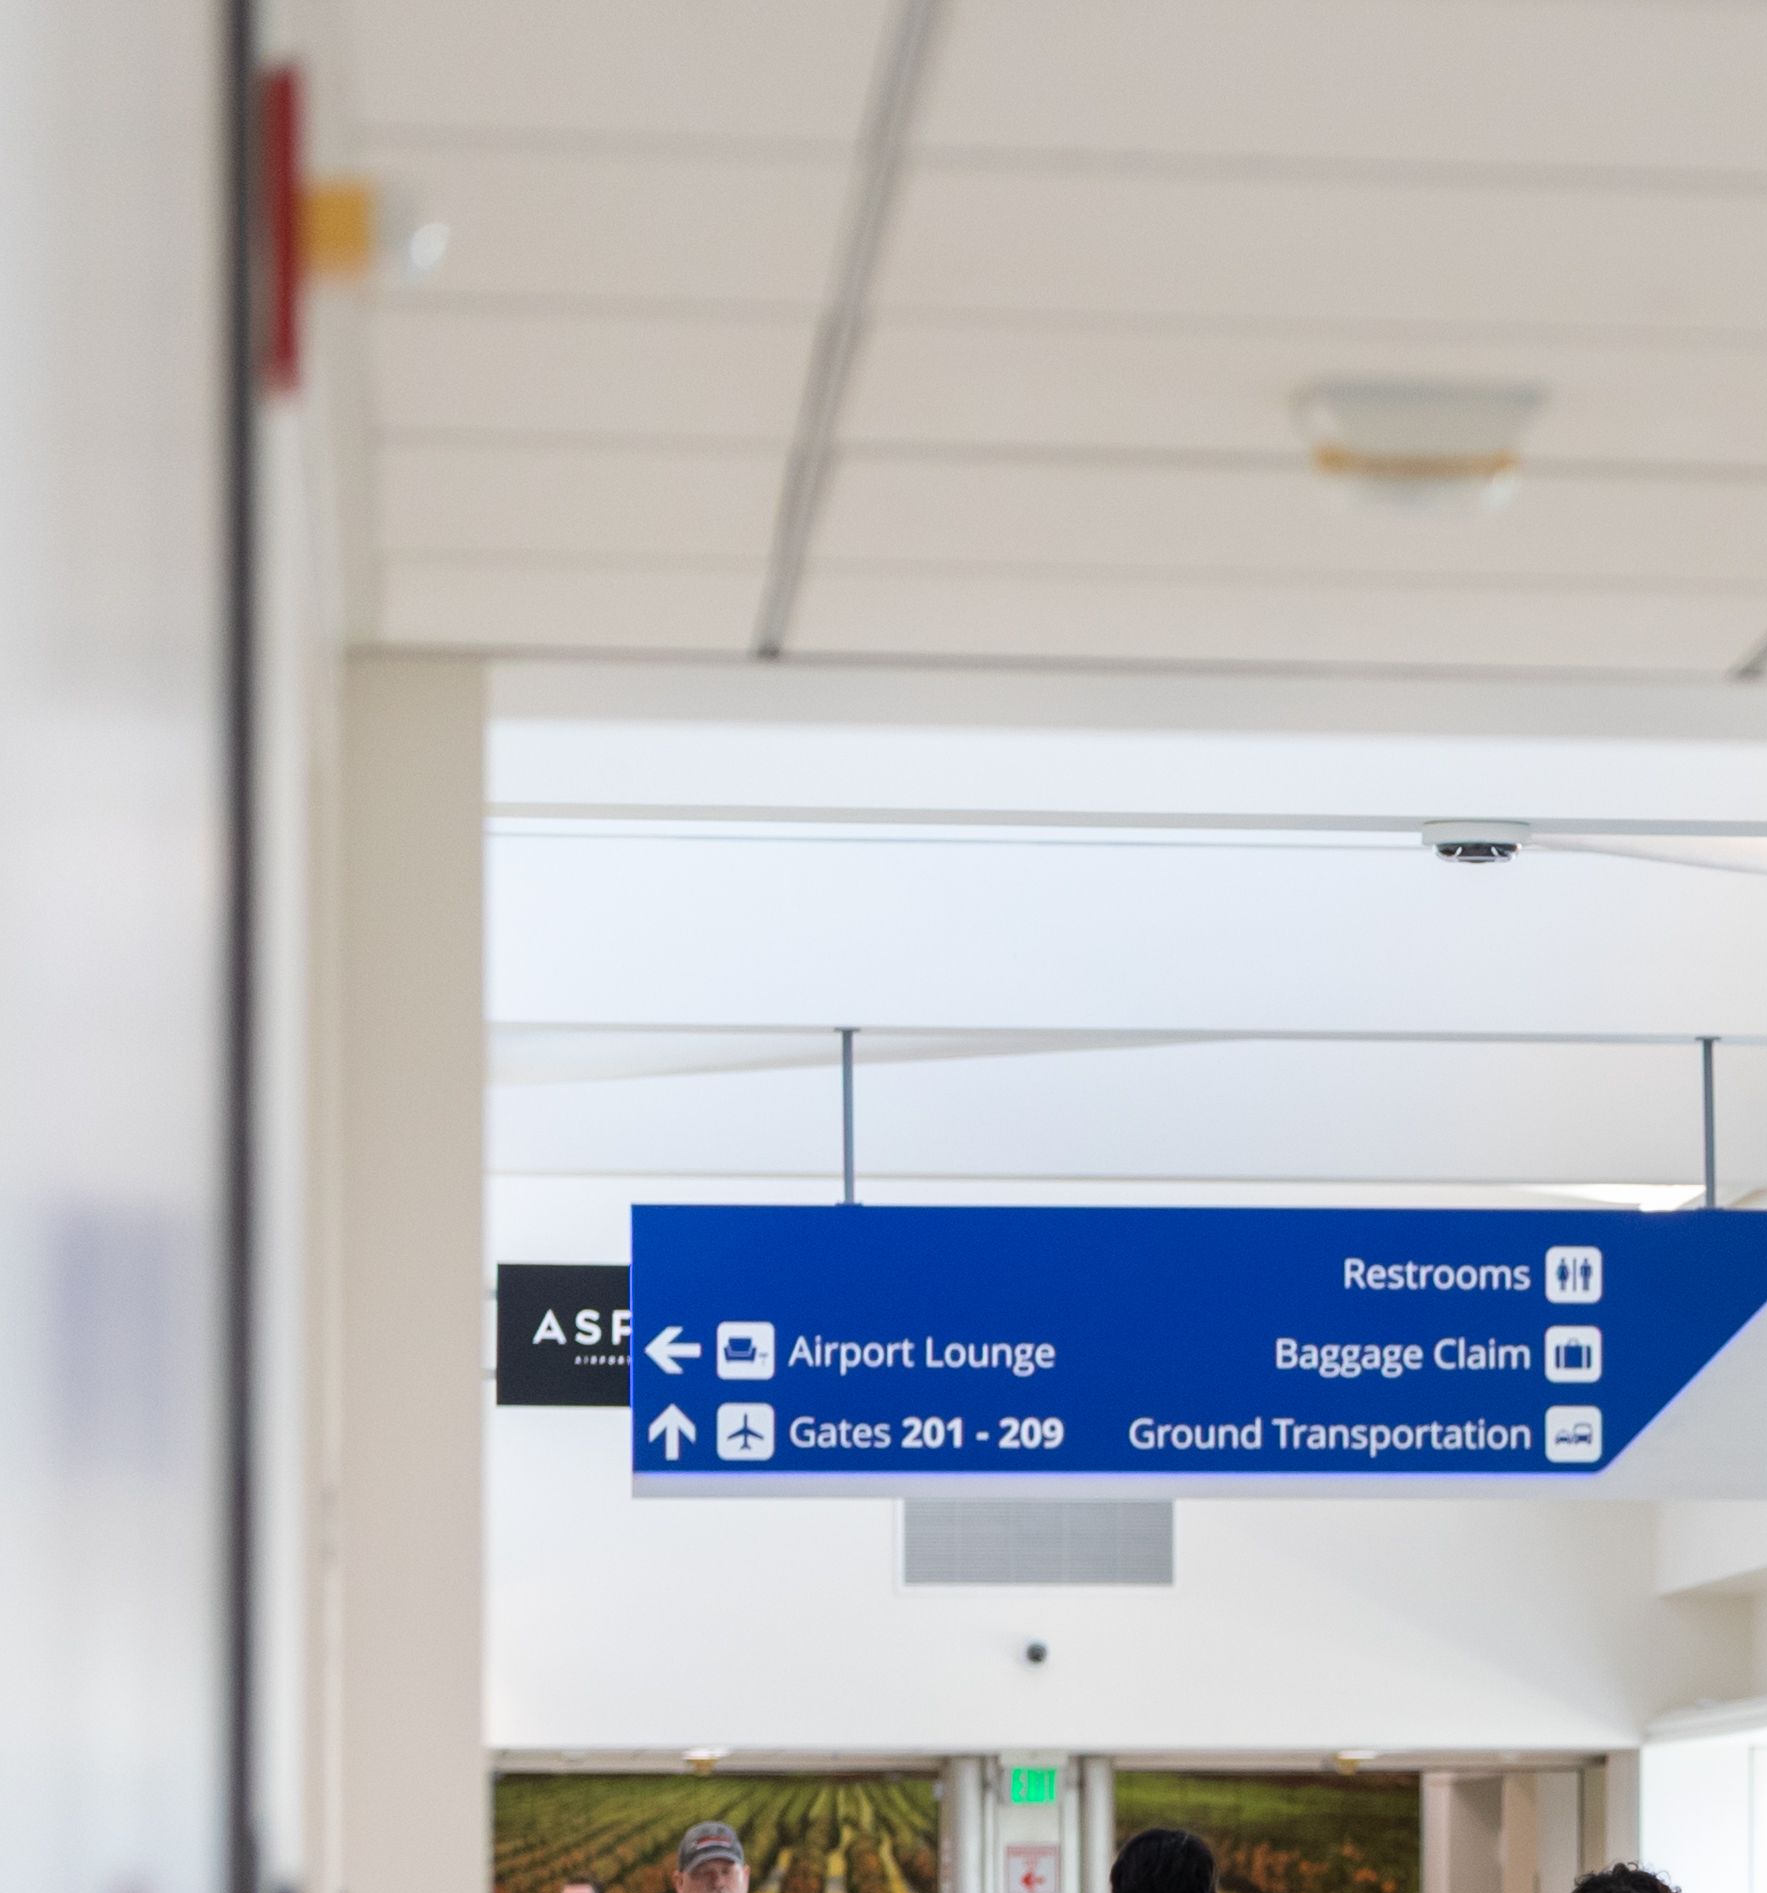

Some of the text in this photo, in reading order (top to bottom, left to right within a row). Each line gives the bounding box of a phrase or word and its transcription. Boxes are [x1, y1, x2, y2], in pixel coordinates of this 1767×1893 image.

[1344, 1257, 1531, 1291] Restrooms
[532, 1308, 633, 1346] ASP
[788, 1335, 1056, 1377] Airport Lounge
[1275, 1336, 1531, 1379] Baggage Claim
[789, 1416, 1065, 1449] Gates 201 - 209
[1129, 1416, 1532, 1458] Ground Transportation
[1011, 1767, 1057, 1804] EXIT
